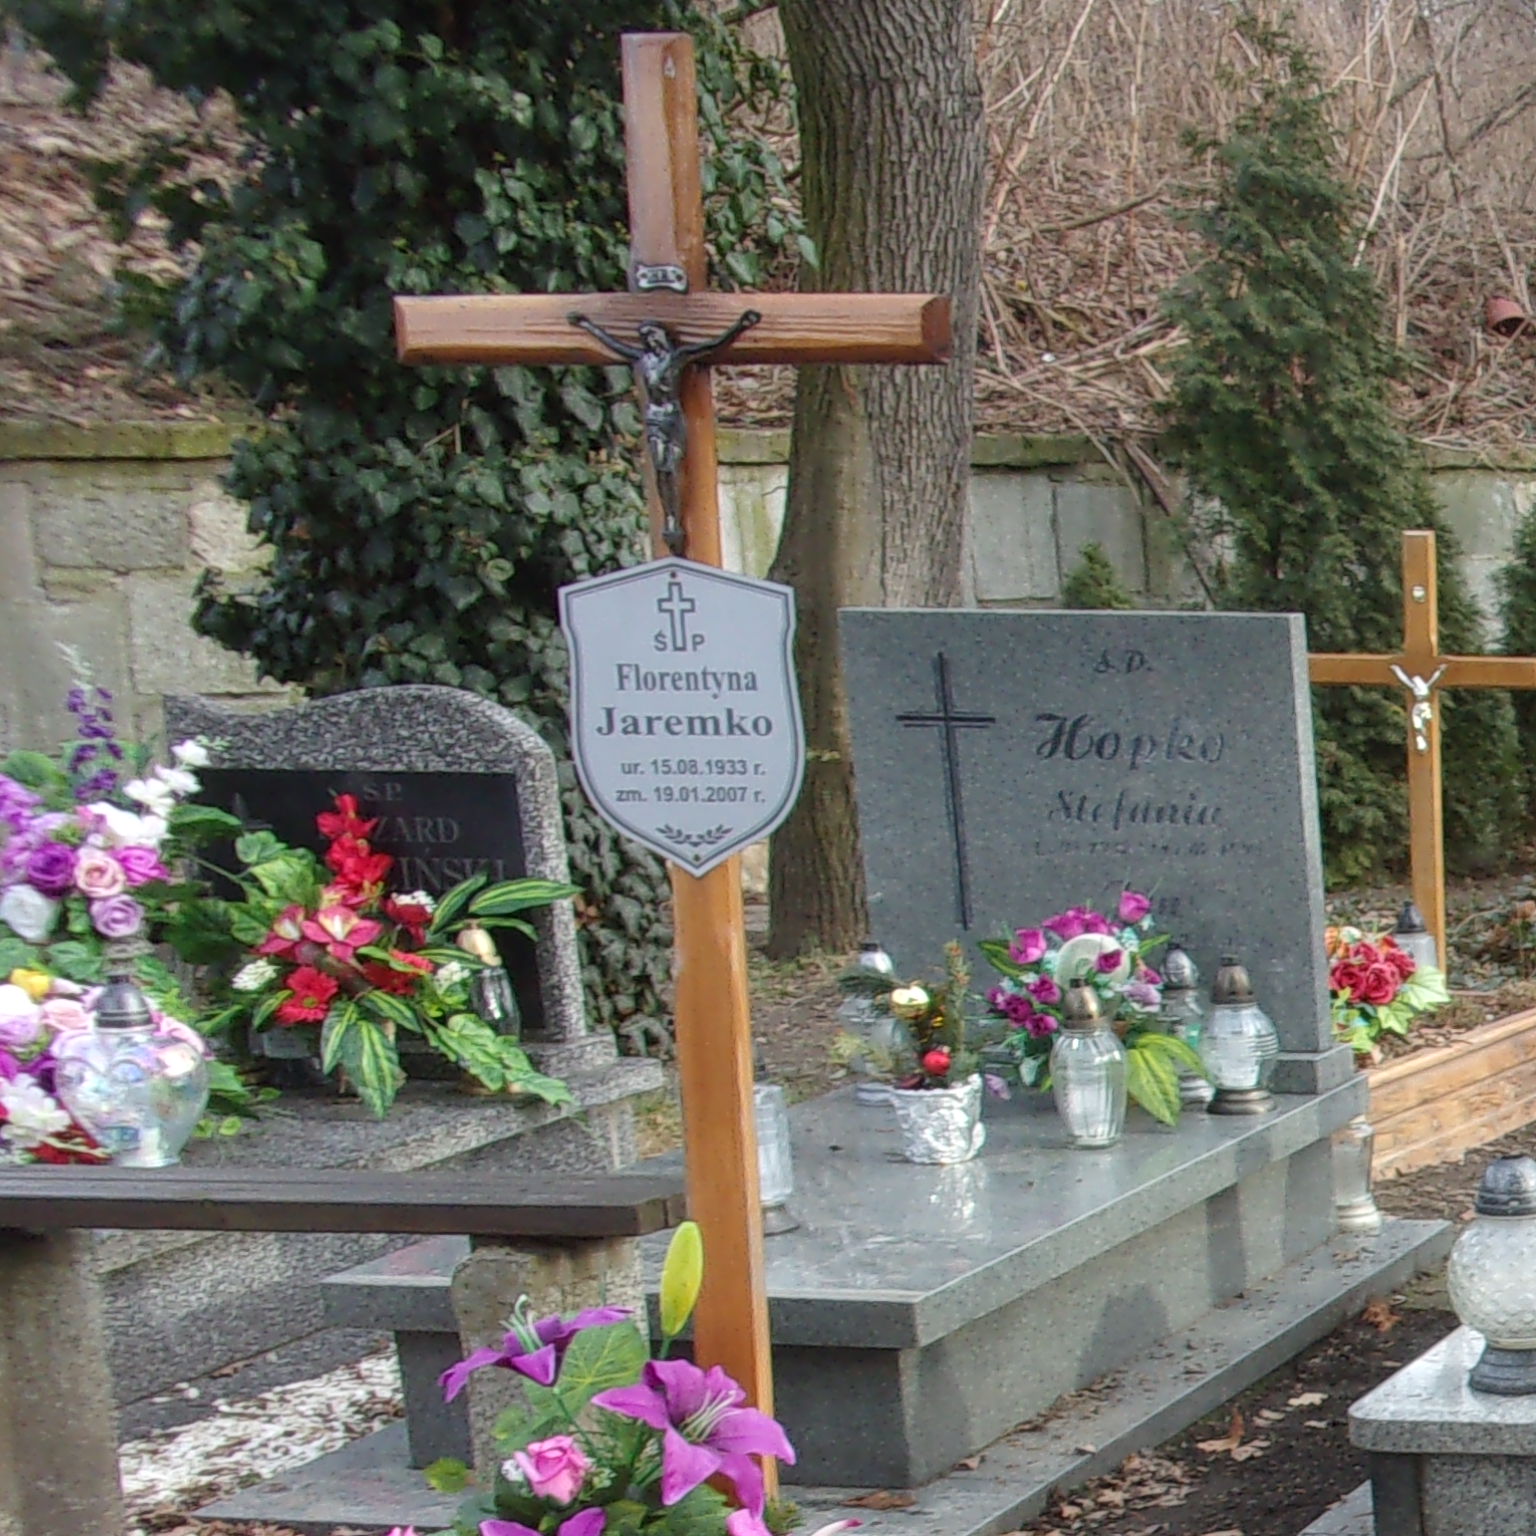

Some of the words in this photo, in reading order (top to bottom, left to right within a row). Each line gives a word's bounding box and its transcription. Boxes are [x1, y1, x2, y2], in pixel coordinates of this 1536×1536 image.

[653, 629, 668, 652] Ś
[691, 634, 705, 652] P
[615, 663, 759, 699] Florentyna
[595, 706, 774, 737] Jaremko
[1034, 713, 1225, 771] Hopko
[620, 763, 645, 776] ur.
[650, 758, 748, 776] 15.08.1933
[752, 764, 767, 776] r.
[615, 788, 648, 803] zm.
[653, 786, 748, 803] 19.01.2007
[753, 793, 767, 803] r.
